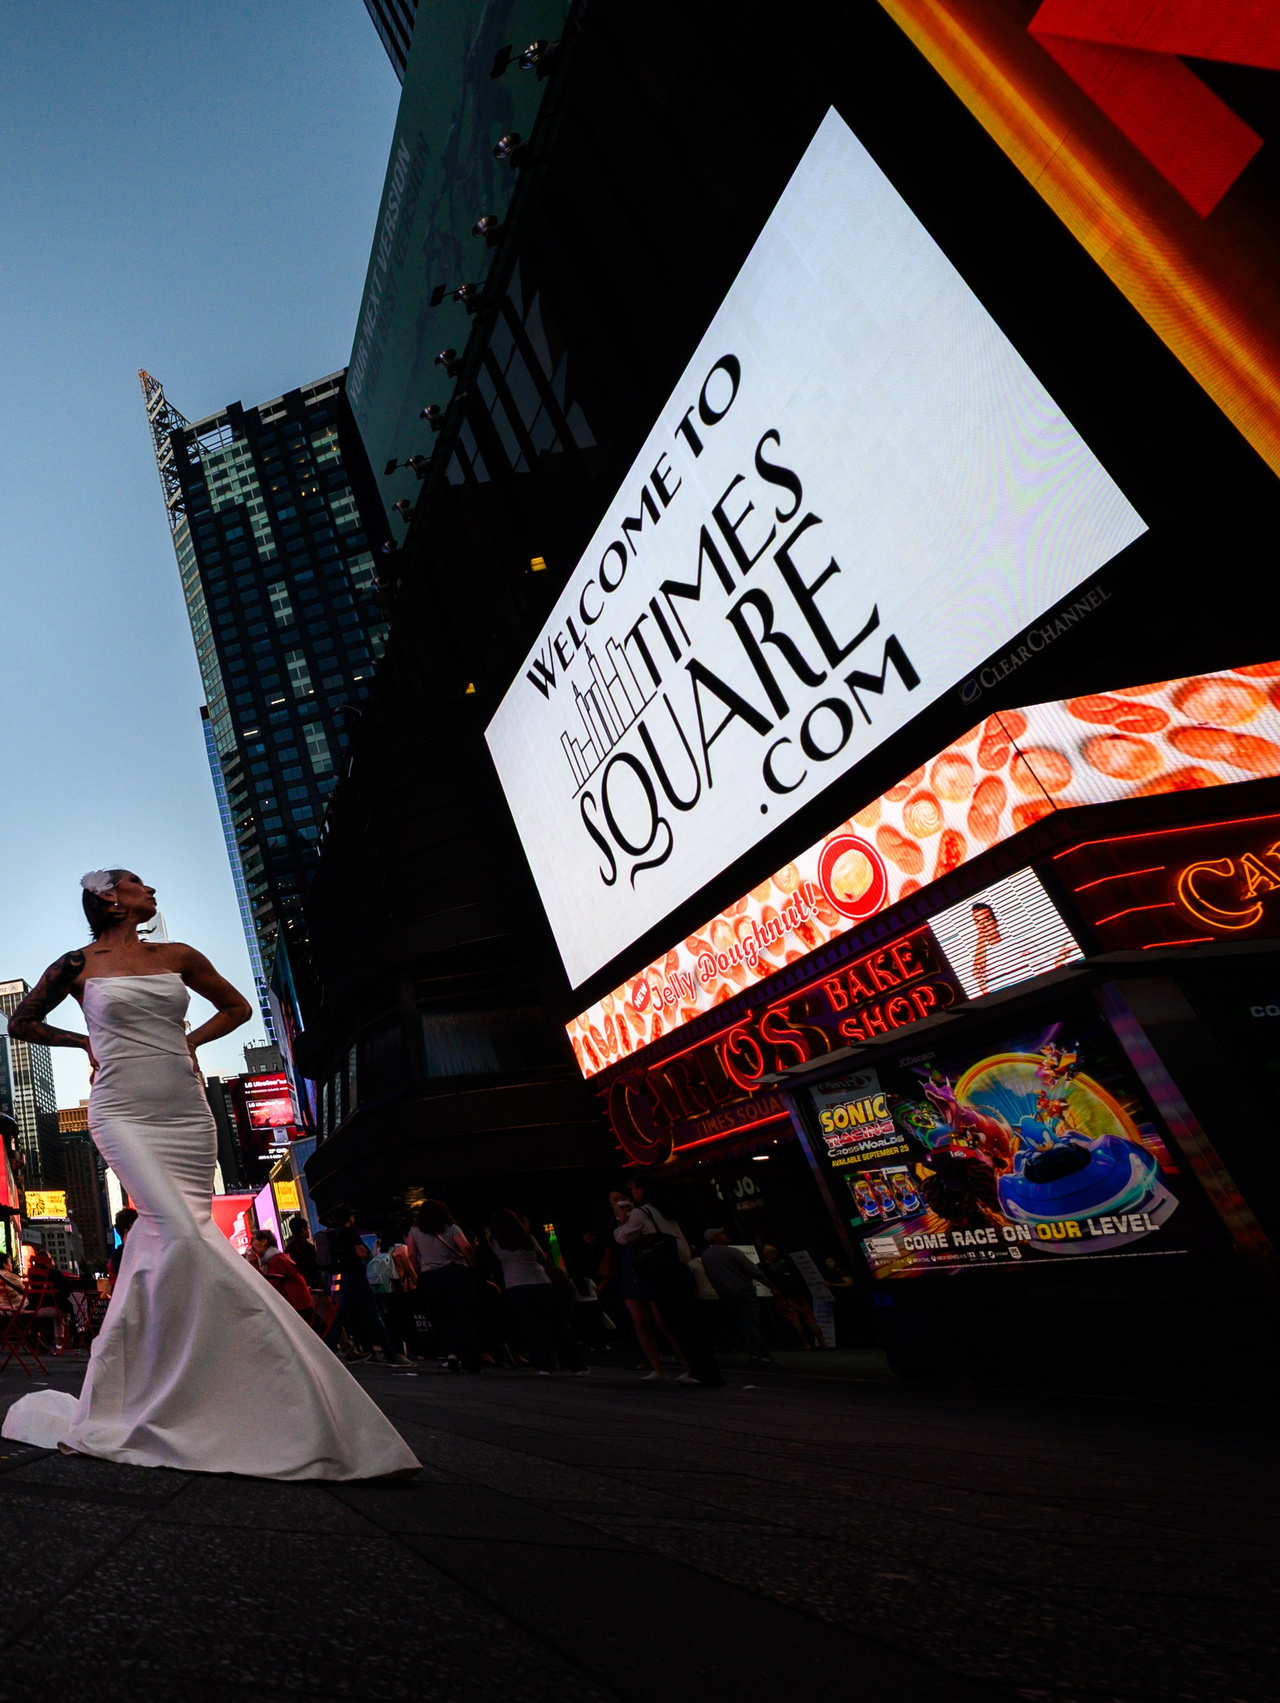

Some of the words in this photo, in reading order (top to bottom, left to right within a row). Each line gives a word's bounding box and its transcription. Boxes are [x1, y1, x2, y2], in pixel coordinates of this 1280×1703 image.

[393, 130, 430, 272] VERSION
[350, 339, 369, 405] YOUR
[362, 266, 382, 346] NEXT
[377, 136, 411, 273] VERSION
[526, 453, 683, 701] WELCOME
[675, 354, 741, 458] TO
[623, 428, 803, 688] TIMES
[580, 513, 880, 890] SQUARE
[760, 634, 921, 814] .COM
[1176, 841, 1280, 930] CA
[634, 981, 648, 1008] NEW
[651, 971, 695, 1012] Jelly
[697, 882, 818, 982] Doughnut!
[823, 940, 924, 1012] BAKE
[838, 986, 937, 1045] SHOP
[898, 1051, 937, 1068] JCDecaux
[695, 1112, 735, 1137] TIMES
[819, 1094, 891, 1134] SONIC
[824, 1120, 896, 1148] RACING
[832, 1154, 862, 1168] AVAILABLE
[862, 1147, 900, 1161] SEPTEMBER
[900, 1143, 910, 1153] 25
[903, 1232, 949, 1251] COME
[951, 1227, 999, 1247] RACE
[1002, 1223, 1032, 1242] ON
[1035, 1219, 1083, 1240] OUR
[1086, 1212, 1160, 1236] LEVEL
